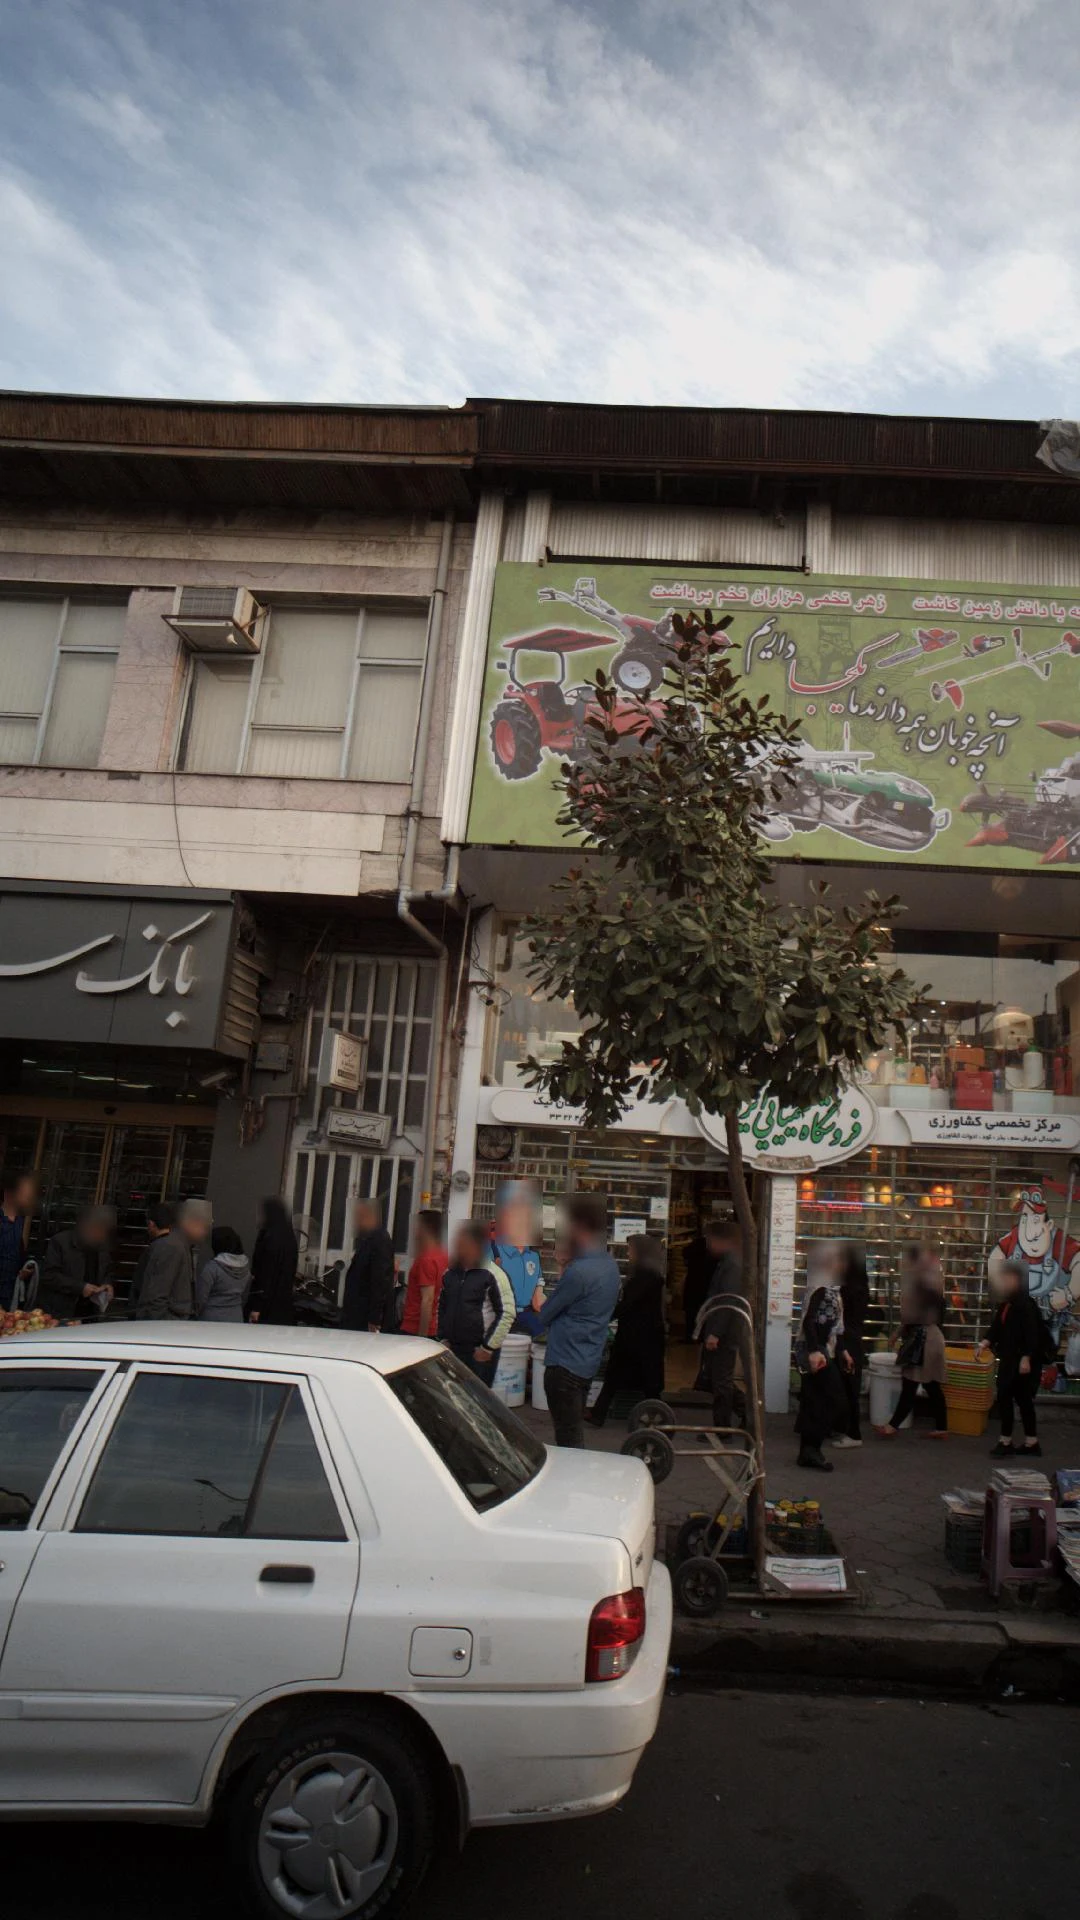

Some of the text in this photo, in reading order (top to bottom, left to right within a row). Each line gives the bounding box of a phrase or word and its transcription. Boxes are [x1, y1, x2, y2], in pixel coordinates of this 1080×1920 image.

[651, 583, 712, 607] برداشت
[717, 585, 748, 608] تخم
[751, 586, 803, 608] هزاران
[914, 595, 959, 612] کاشت
[964, 599, 1001, 619] زمین
[1007, 600, 1047, 619] دانش
[745, 617, 796, 674] داریم
[76, 910, 213, 1028] بانک
[929, 1115, 1061, 1132] مرکز تخصصی کشاورزی
